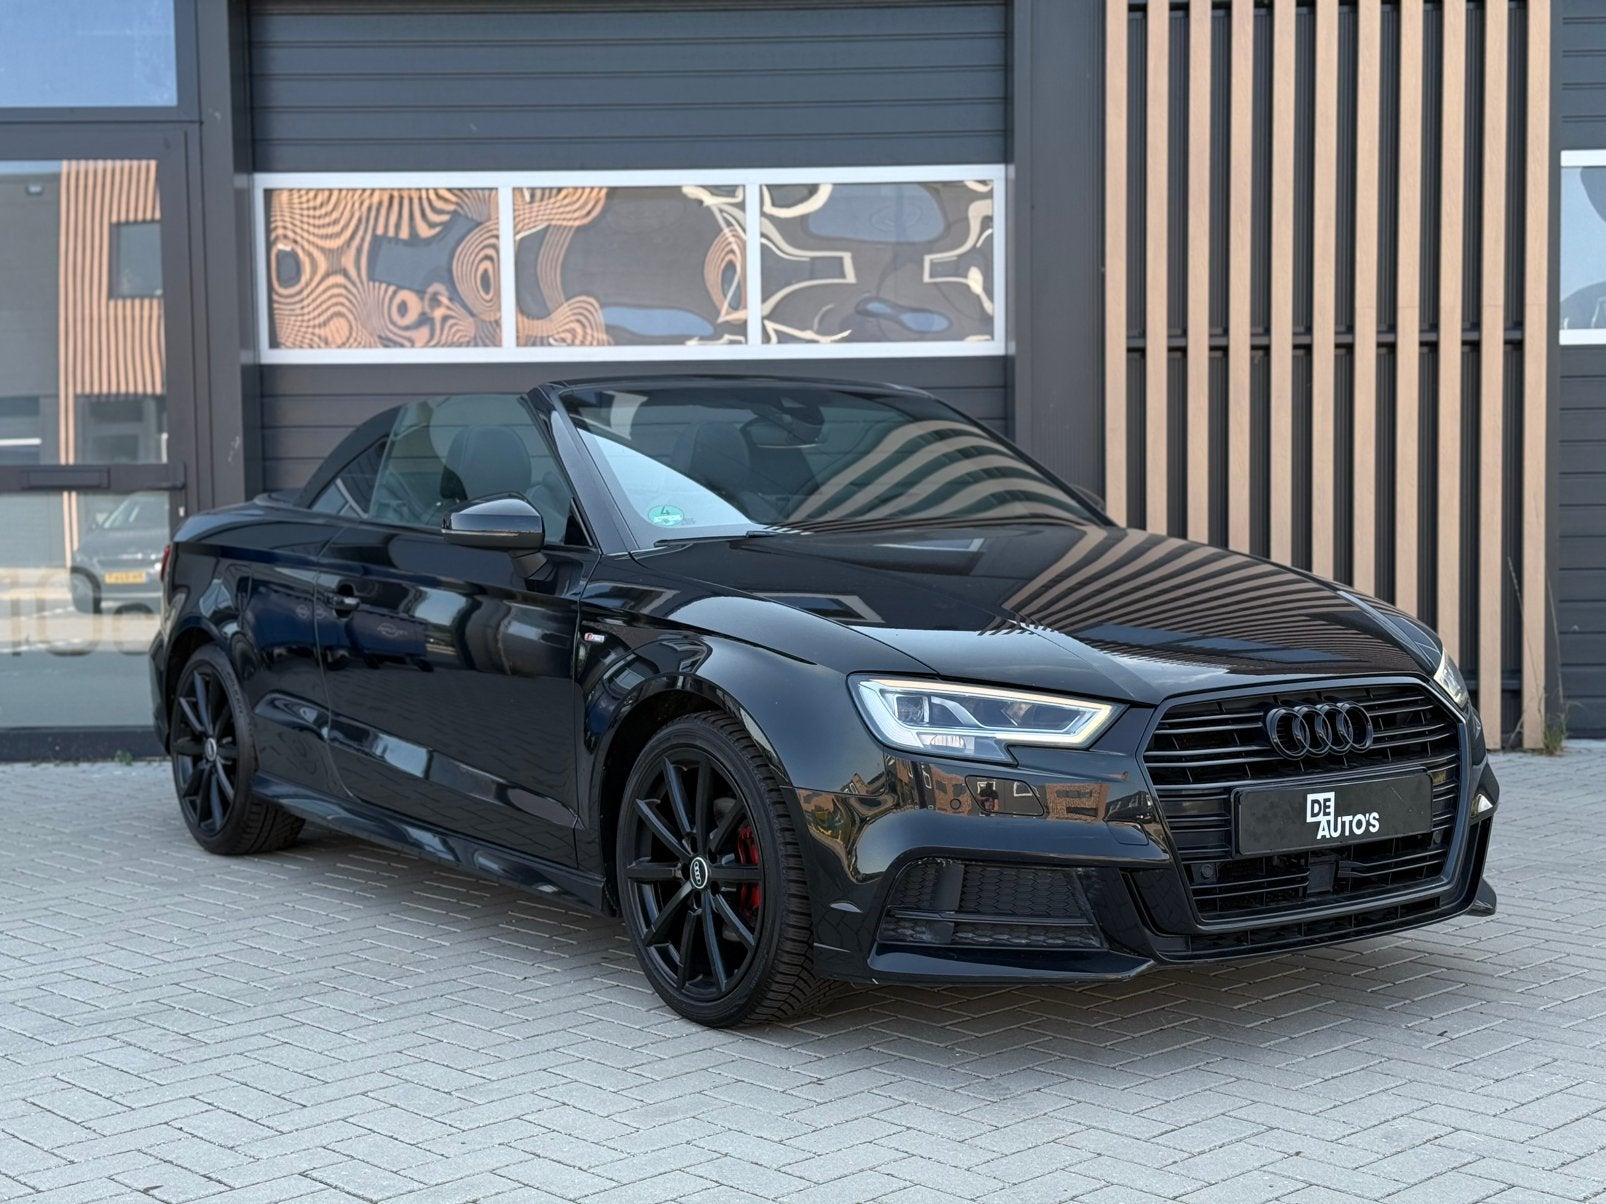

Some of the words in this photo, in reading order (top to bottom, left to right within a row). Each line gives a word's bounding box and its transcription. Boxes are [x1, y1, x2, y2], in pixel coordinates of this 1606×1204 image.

[660, 505, 671, 515] 4
[1309, 796, 1333, 819] DE
[1316, 812, 1380, 840] AUTO'S
